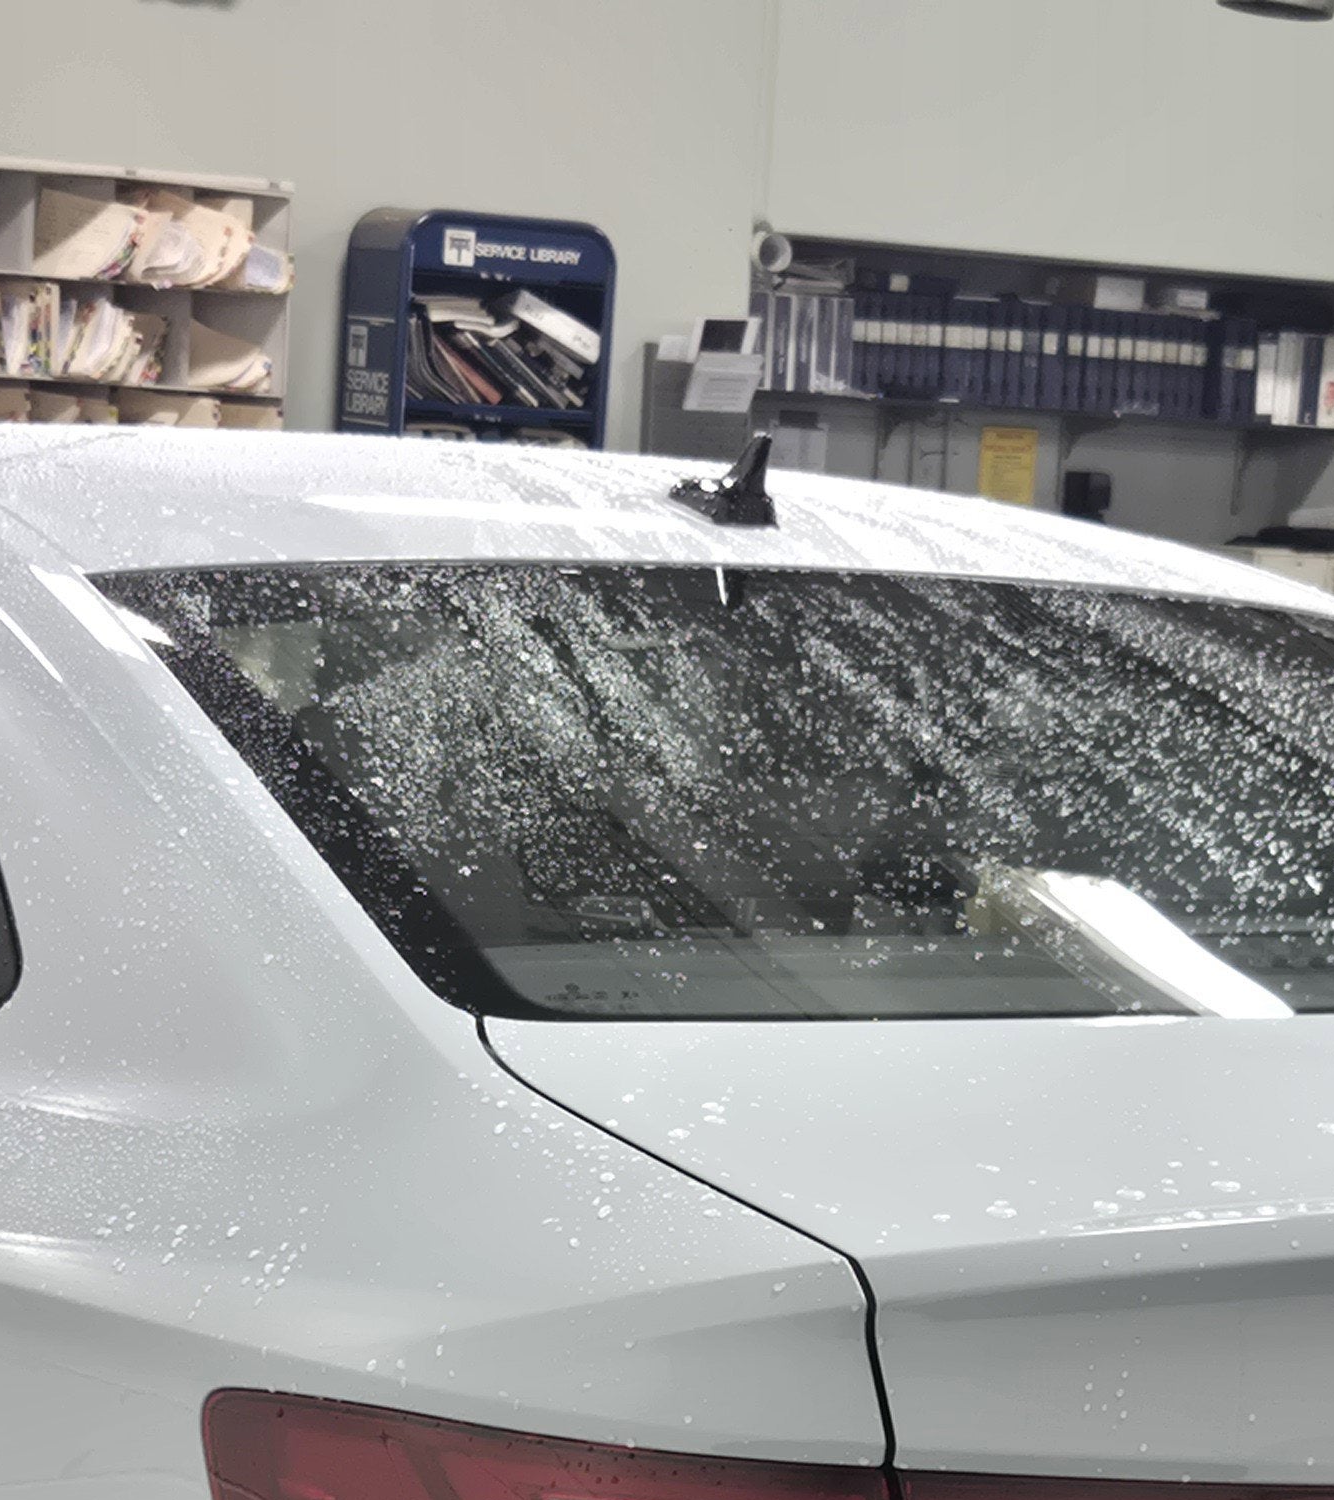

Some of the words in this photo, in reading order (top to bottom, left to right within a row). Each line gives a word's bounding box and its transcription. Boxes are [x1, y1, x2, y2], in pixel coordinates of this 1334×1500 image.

[475, 242, 527, 261] SERVICE
[530, 247, 582, 266] LIBRARY
[347, 369, 389, 394] SERVICE
[346, 391, 388, 416] LIBRARY
